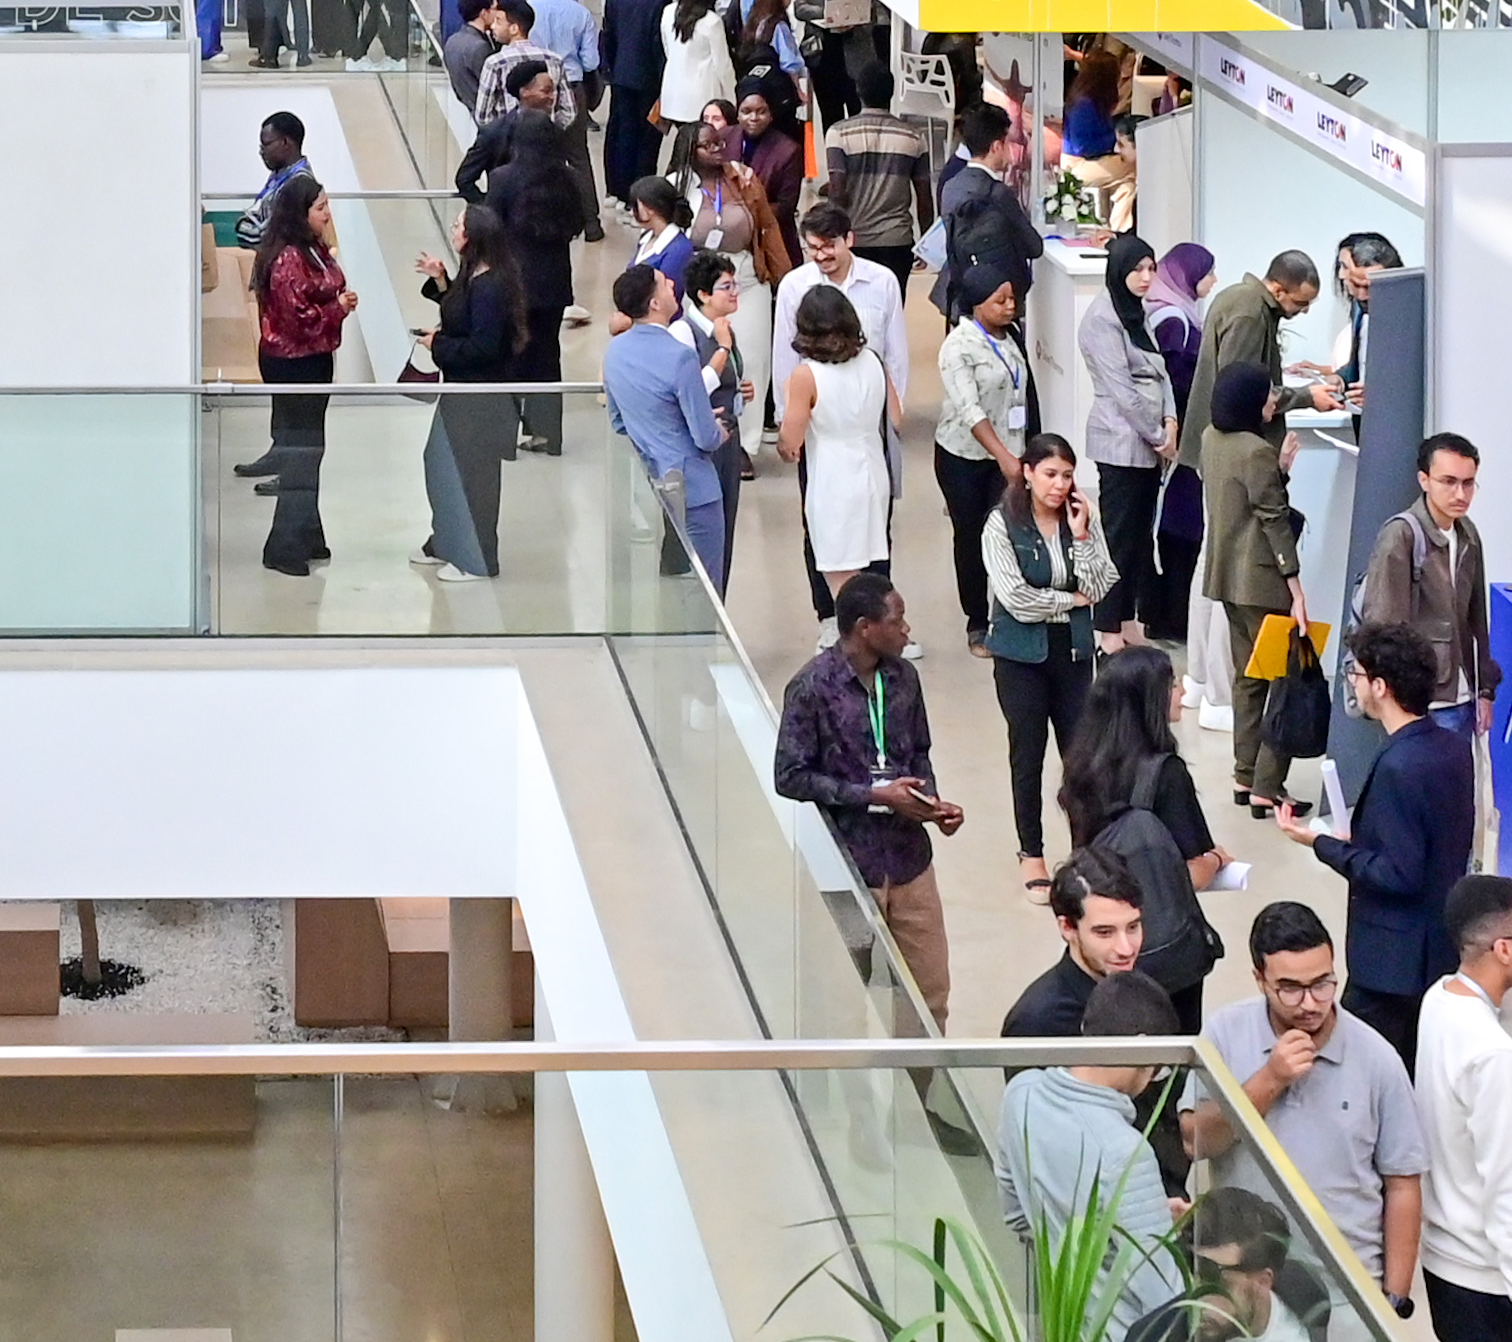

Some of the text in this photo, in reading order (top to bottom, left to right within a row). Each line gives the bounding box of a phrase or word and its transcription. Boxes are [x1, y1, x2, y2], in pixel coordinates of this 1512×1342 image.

[1221, 57, 1245, 84] LEYTON
[1267, 84, 1294, 113] LEYTON
[1317, 112, 1346, 141] LEYTON
[1372, 140, 1402, 172] LEYTON
